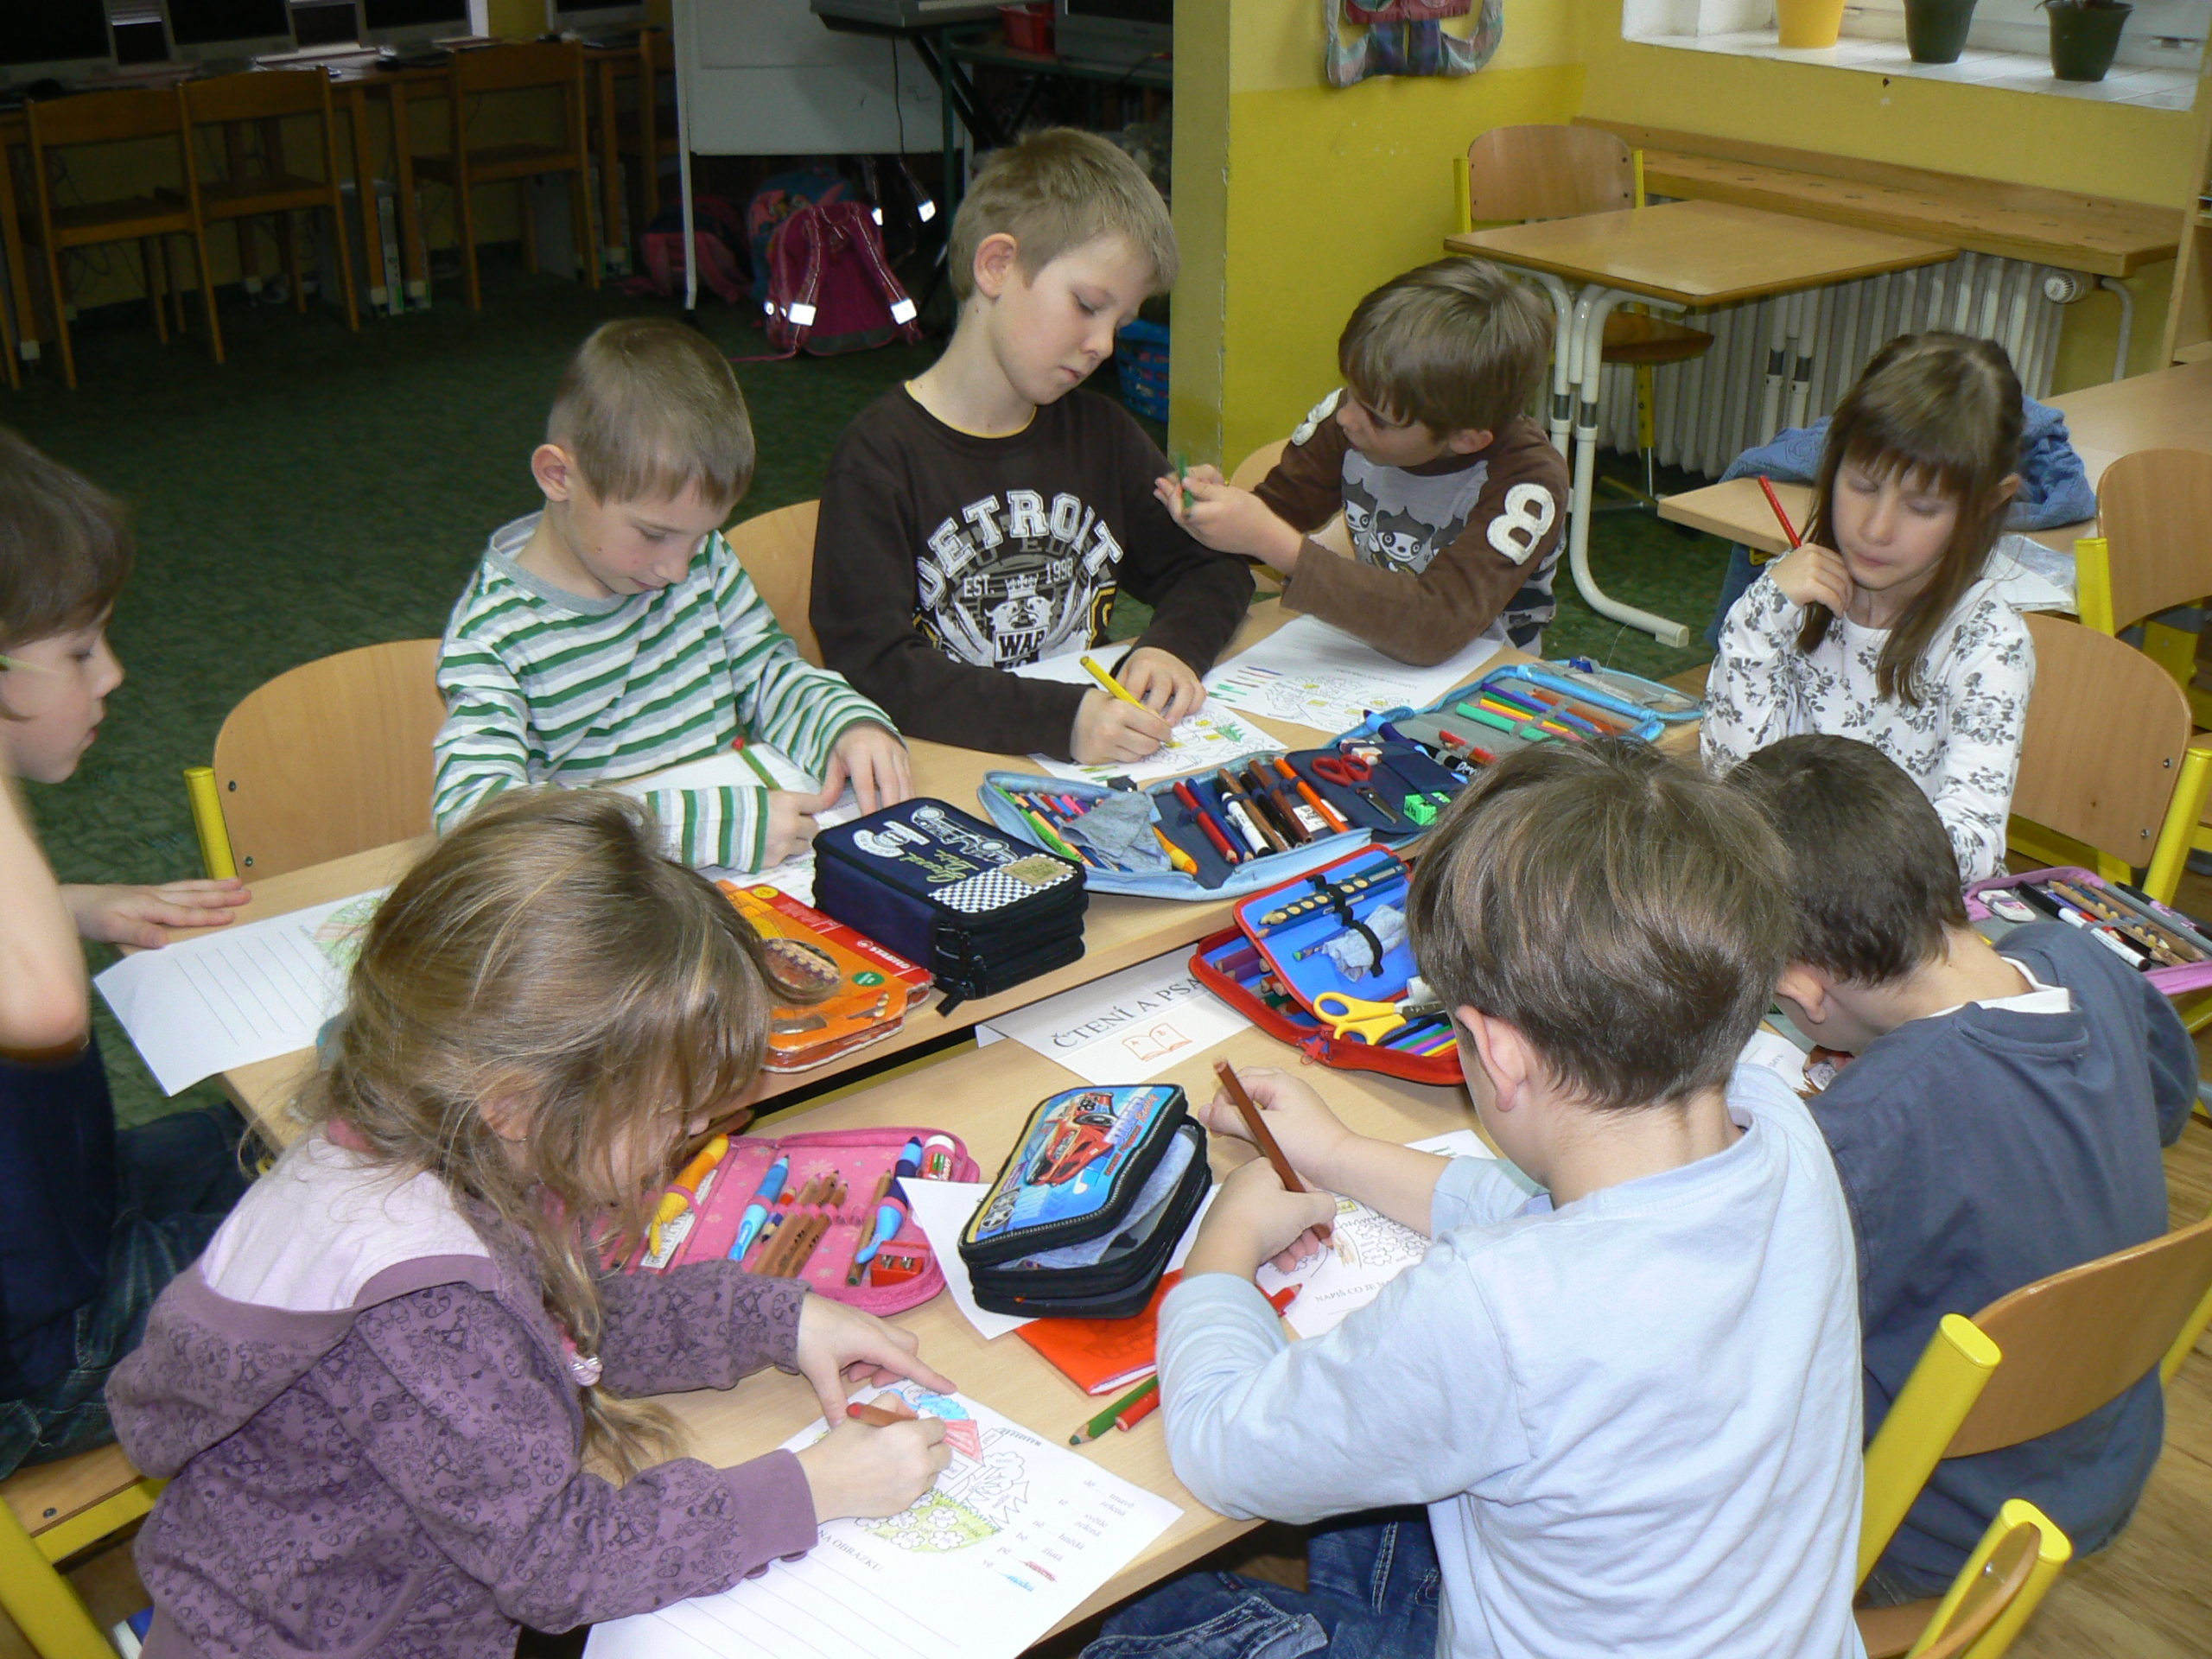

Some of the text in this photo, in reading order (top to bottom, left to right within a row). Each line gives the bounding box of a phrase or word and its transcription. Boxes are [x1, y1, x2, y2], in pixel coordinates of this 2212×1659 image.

[916, 489, 1123, 611] DETROIT
[963, 557, 1073, 598] EST. 1998
[1053, 977, 1202, 1048] ČTENÍ A PSA
